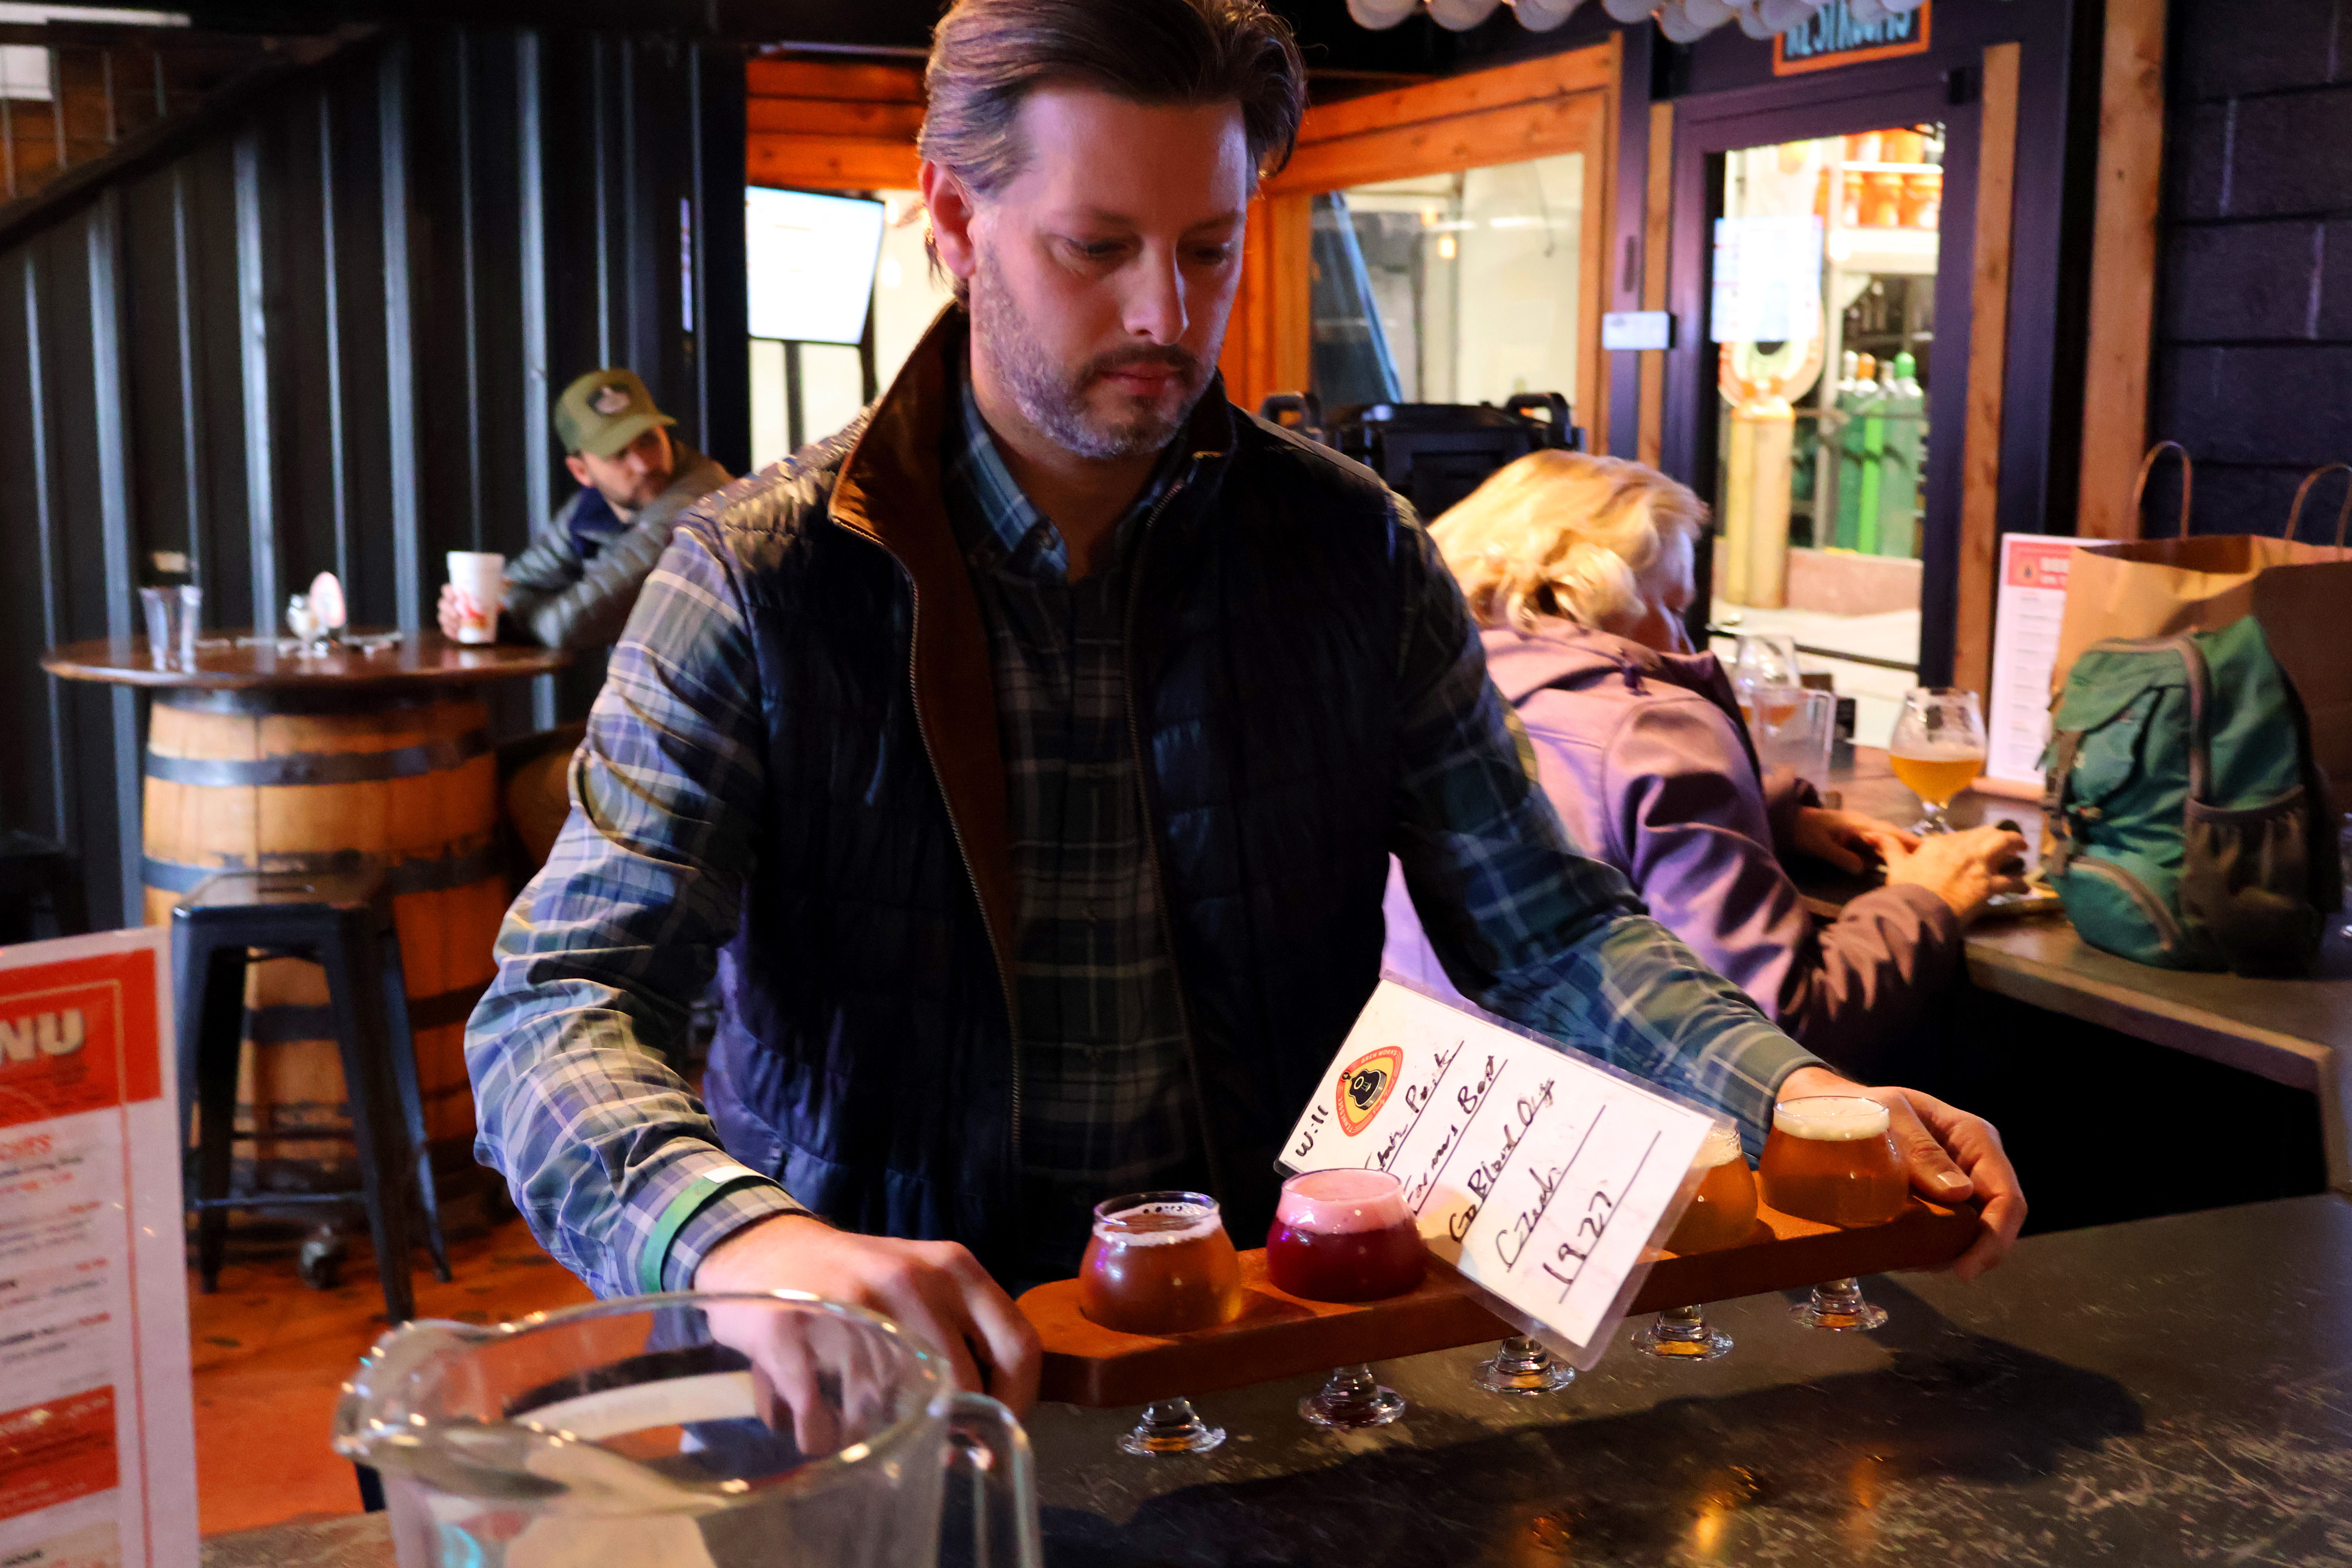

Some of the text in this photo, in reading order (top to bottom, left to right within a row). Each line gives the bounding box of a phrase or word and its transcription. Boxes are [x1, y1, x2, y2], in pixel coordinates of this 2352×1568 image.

[1361, 1053, 1377, 1063] BREW
[1295, 1105, 1328, 1156] Will
[1338, 1096, 1353, 1132] TENNESSEE
[1542, 1191, 1612, 1284] 1927
